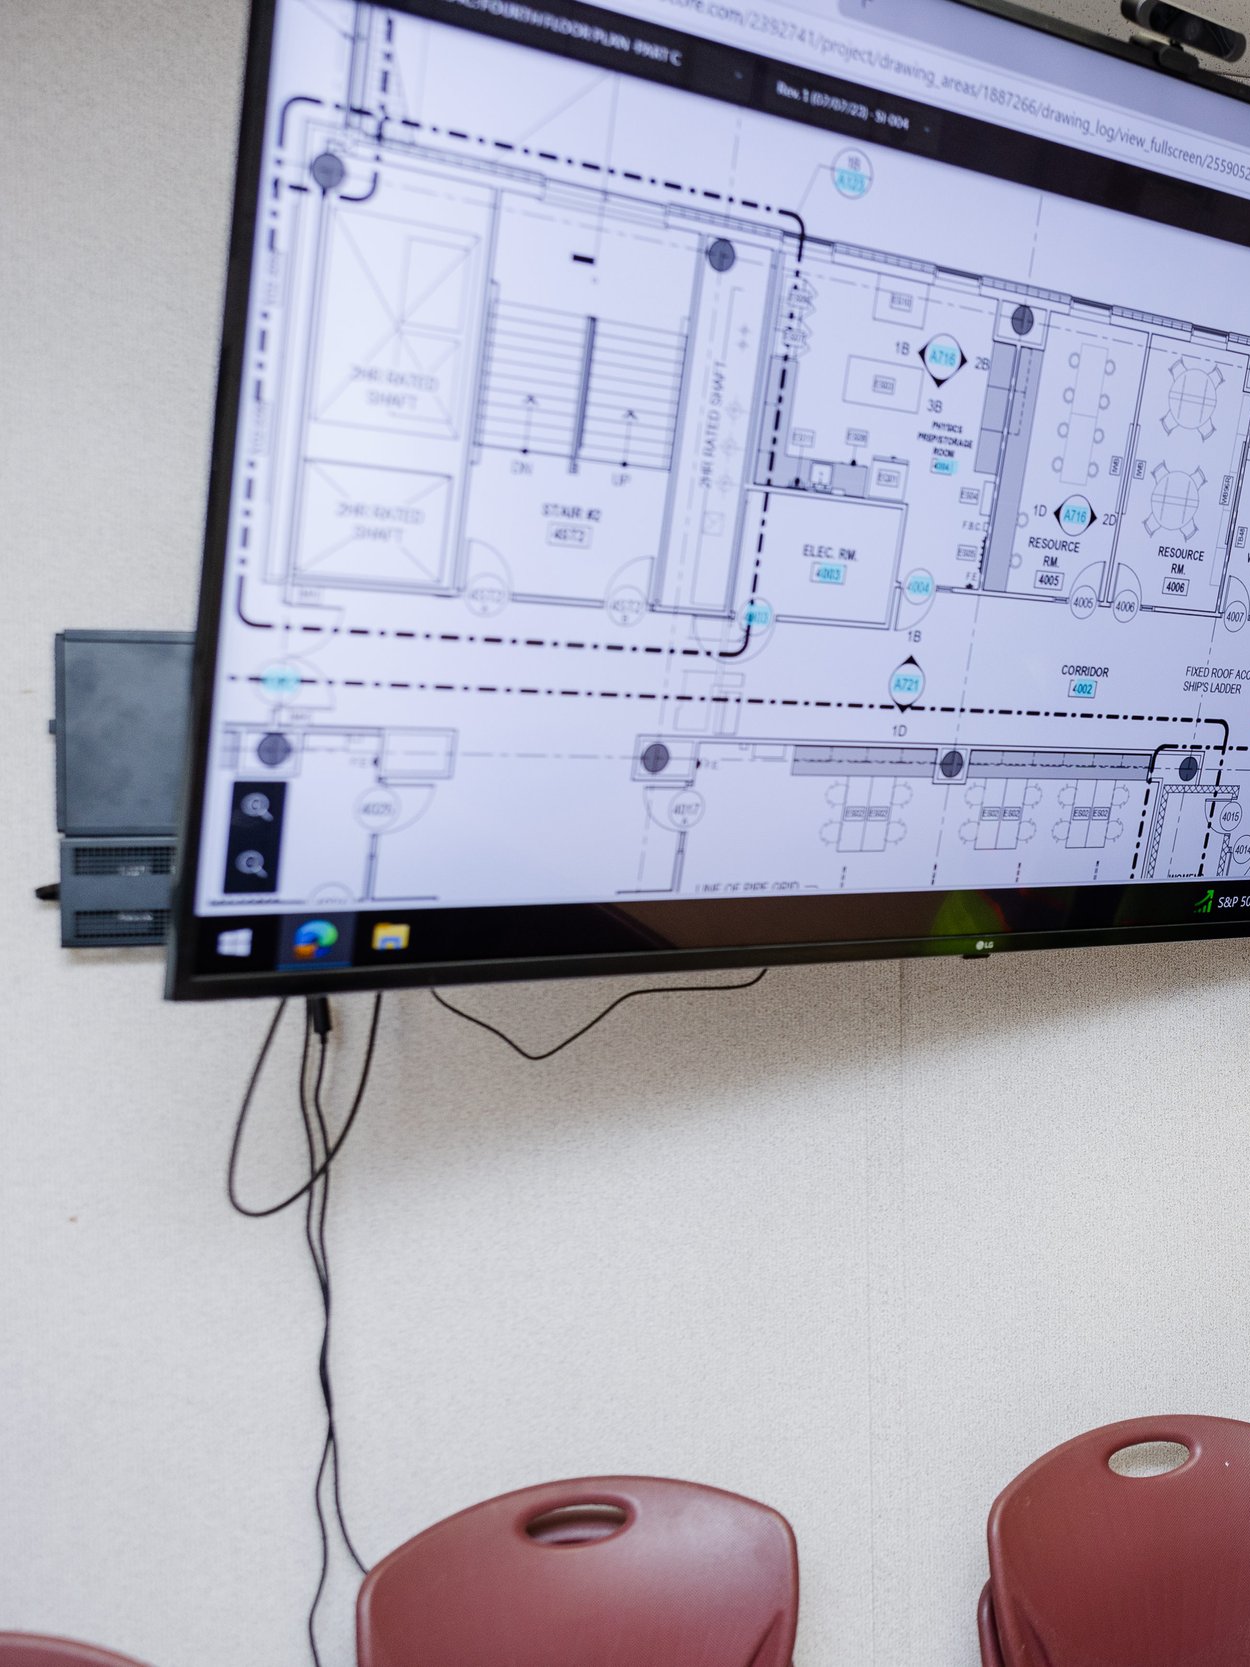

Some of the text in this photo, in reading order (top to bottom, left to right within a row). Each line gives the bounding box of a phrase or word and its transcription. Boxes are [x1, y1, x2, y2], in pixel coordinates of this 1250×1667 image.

[669, 49, 683, 67] C
[896, 341, 910, 355] 1B
[974, 356, 990, 371] 2B
[1033, 504, 1047, 517] 1D
[1063, 507, 1087, 524] A716
[1102, 513, 1117, 526] 2D
[1028, 537, 1081, 553] RESOURCE
[1158, 546, 1205, 562] RESOURCE
[1043, 556, 1059, 568] RM.
[1171, 564, 1186, 575] RM.
[1038, 575, 1060, 586] 4005
[1166, 582, 1185, 593] 4006
[1073, 597, 1094, 609] 4005
[1115, 601, 1136, 613] 4006
[1226, 612, 1244, 623] 4007
[908, 630, 921, 643] 1B
[1061, 664, 1110, 678] CORRIDOR
[1186, 666, 1210, 678] FIXED
[1211, 667, 1234, 679] ROOF
[1073, 683, 1092, 694] 4002
[1183, 681, 1242, 695] SHIP'S LADDER
[892, 724, 907, 737] 1D
[1073, 809, 1089, 817] ES02
[1093, 809, 1109, 817] ES02
[1222, 811, 1239, 821] 4015
[1217, 897, 1238, 908] S&P
